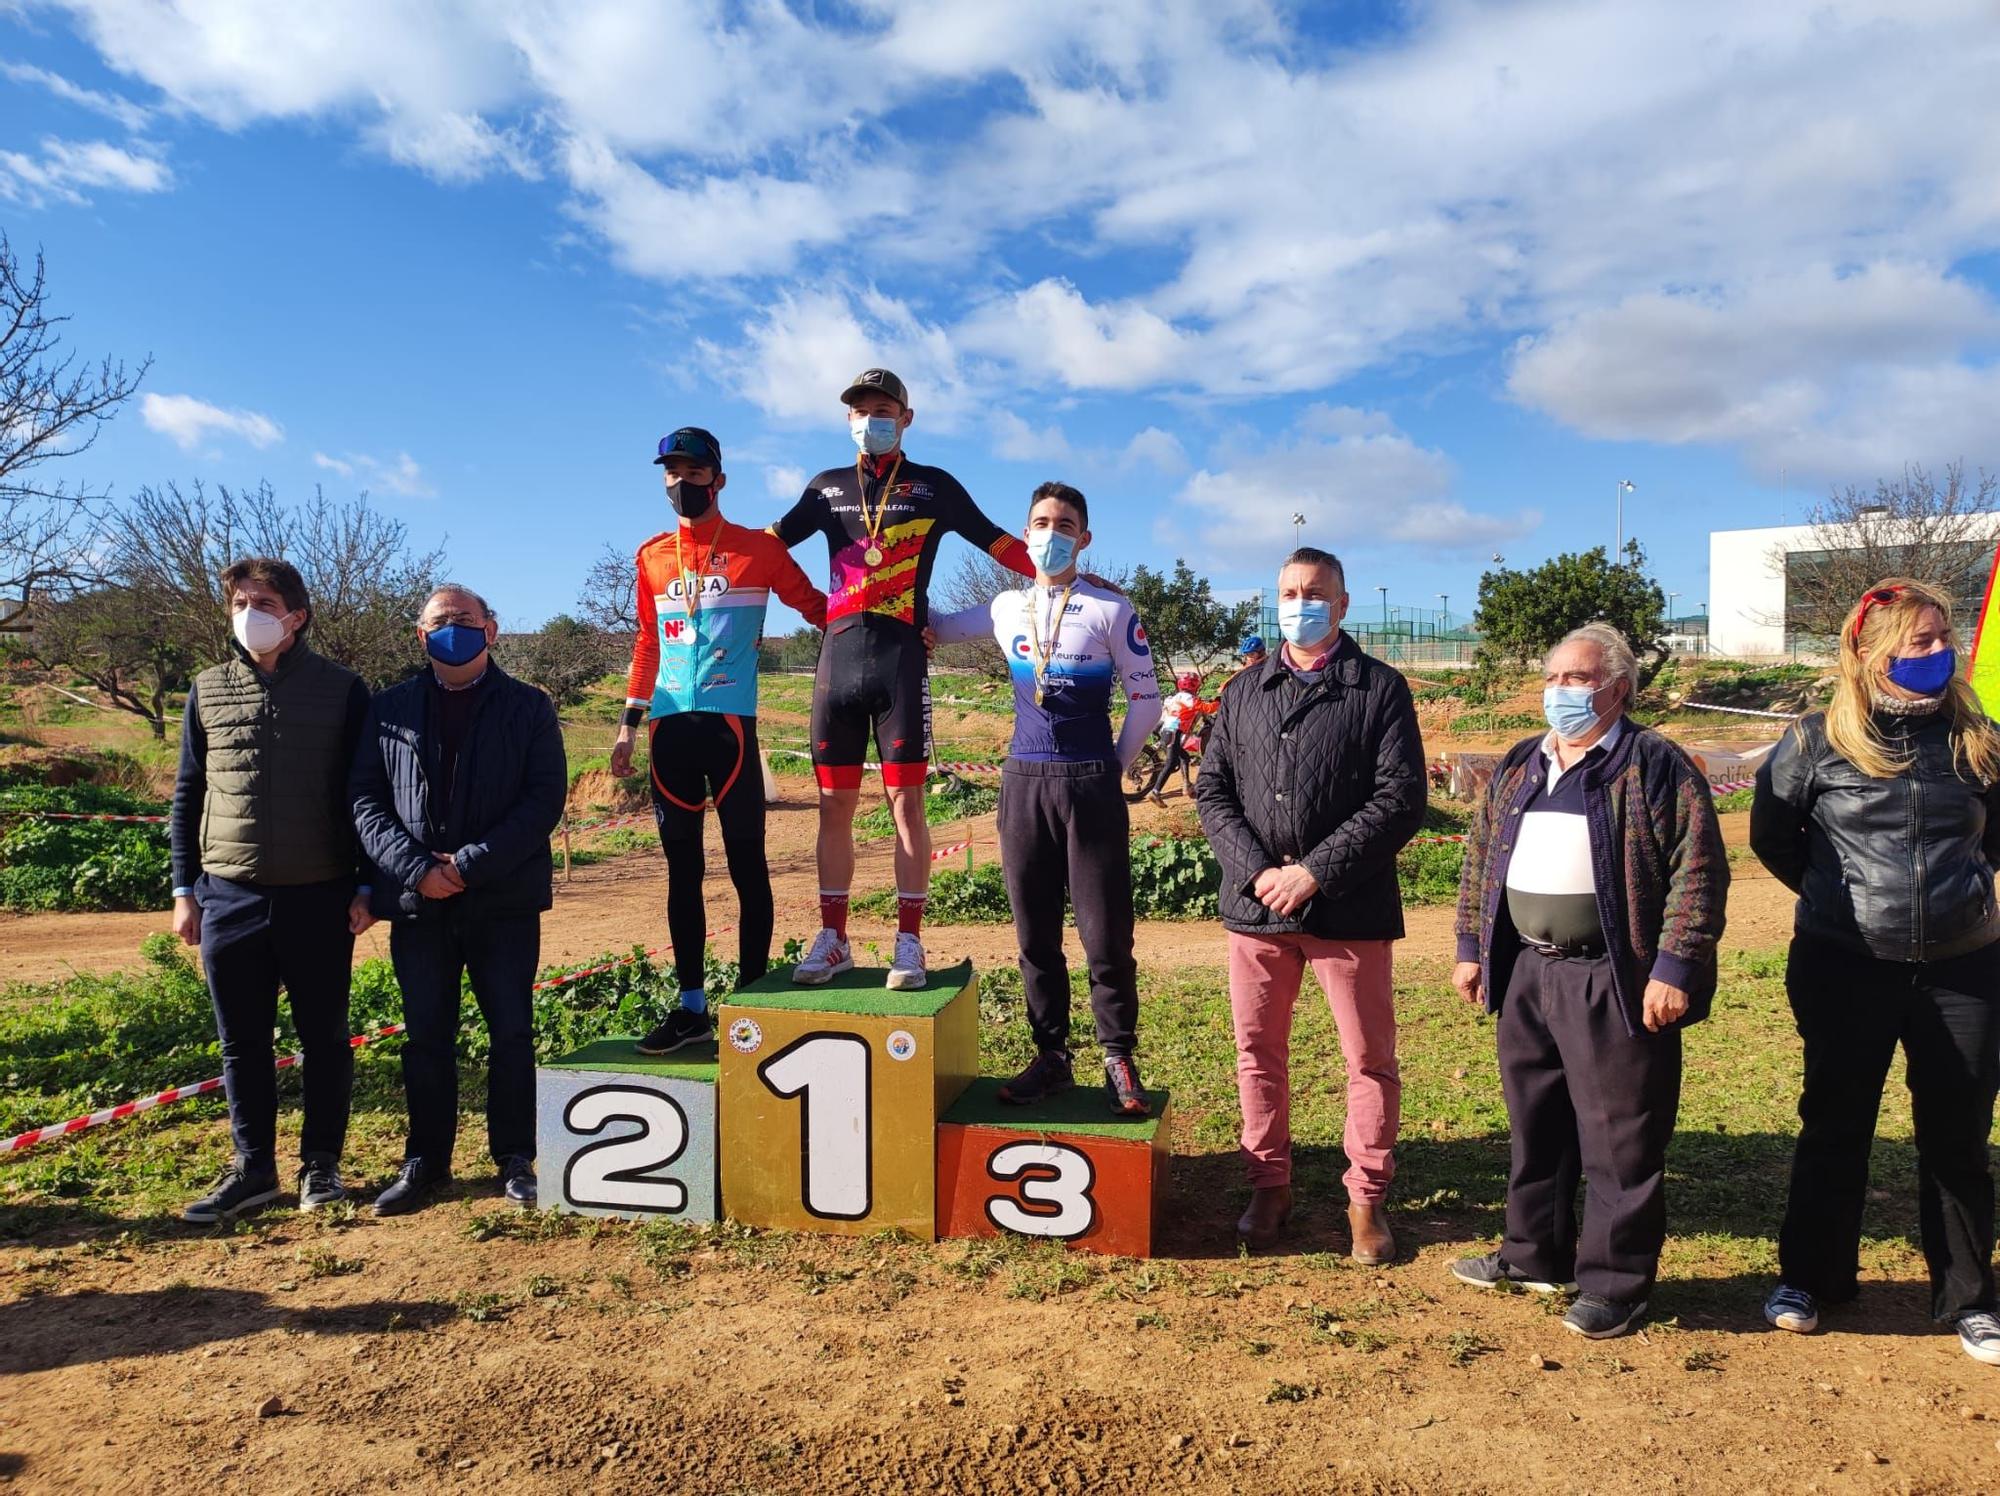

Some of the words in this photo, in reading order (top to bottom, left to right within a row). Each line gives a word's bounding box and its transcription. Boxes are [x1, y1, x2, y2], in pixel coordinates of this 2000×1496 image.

[675, 578, 722, 596] DIBA
[1057, 652, 1093, 663] europa
[563, 1085, 688, 1213] 2
[757, 1031, 872, 1220] 1
[985, 1139, 1096, 1239] 3
